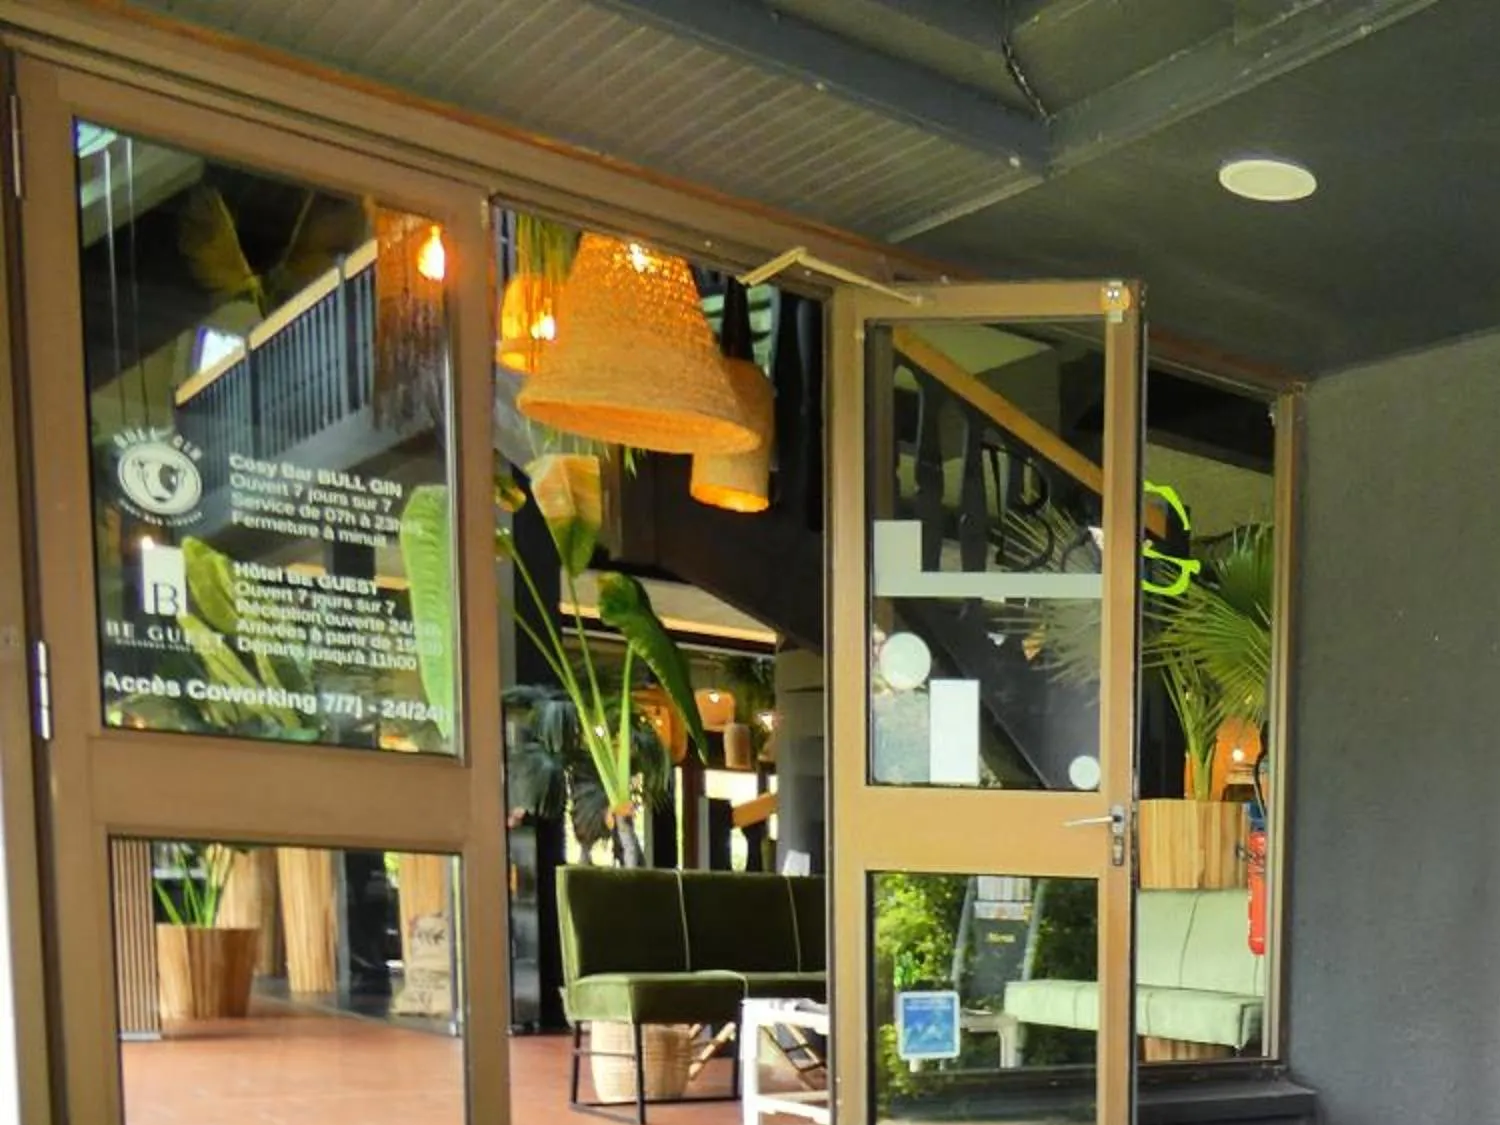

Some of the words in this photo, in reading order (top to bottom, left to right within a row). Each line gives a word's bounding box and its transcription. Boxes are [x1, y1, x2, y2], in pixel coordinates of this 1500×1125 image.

[113, 427, 169, 449] BULL
[228, 452, 278, 479] Cosy
[282, 461, 312, 482] Bar
[317, 468, 366, 492] BULL
[369, 478, 403, 498] GIN
[229, 472, 289, 497] Ouvert
[292, 484, 302, 499] 7
[308, 486, 349, 506] jours
[352, 496, 378, 512] sur
[382, 497, 393, 512] 7
[230, 491, 296, 517] Service
[299, 503, 321, 519] de
[324, 506, 356, 525] 07h
[360, 510, 371, 529] à
[374, 515, 424, 536] 23h
[230, 509, 319, 539] Fermeture
[323, 522, 335, 541] à
[339, 527, 388, 549] minuit
[233, 561, 283, 583] Hôtel
[317, 574, 378, 597] GUEST
[234, 580, 293, 602] Ouvert
[297, 588, 308, 604] 7
[311, 593, 352, 611] jours
[355, 598, 382, 614] sur
[386, 600, 397, 616] 7
[236, 599, 321, 625] Réception
[325, 613, 385, 633] ouverte
[310, 625, 322, 644] à
[325, 630, 365, 649] partir
[370, 633, 392, 651] de
[308, 645, 368, 666] jusqu'à
[372, 651, 417, 671] 11h00
[104, 670, 181, 698] Accès
[186, 678, 317, 715] Coworking
[321, 691, 363, 720] 7/7j
